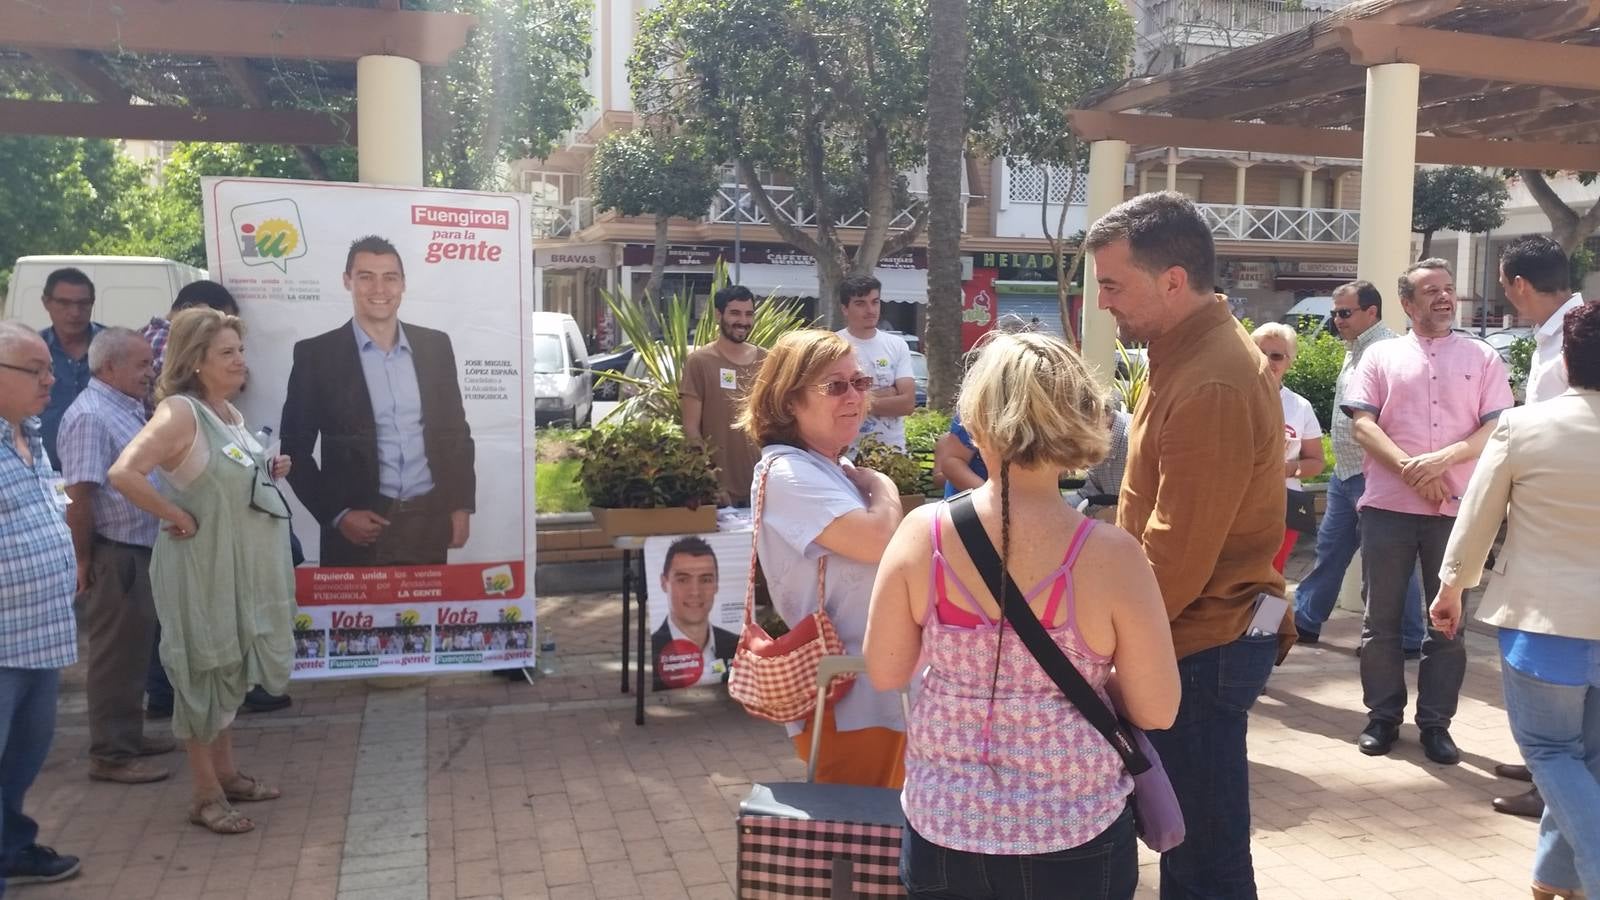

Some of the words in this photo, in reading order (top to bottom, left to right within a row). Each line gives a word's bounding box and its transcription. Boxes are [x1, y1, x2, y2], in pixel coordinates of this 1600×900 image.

[414, 207, 507, 226] Fuengirola
[432, 230, 462, 240] para
[464, 230, 476, 240] la
[425, 240, 502, 263] gente
[551, 254, 596, 263] BRAVAS
[491, 368, 519, 376] ESPAÑA
[362, 571, 387, 579] unida
[314, 592, 367, 600] FUENGIROLA
[413, 589, 442, 597] GENTE
[331, 611, 374, 629] Vota
[436, 608, 478, 625] Vota
[331, 658, 378, 668] Fuengirola
[401, 655, 431, 665] gente
[436, 654, 482, 664] Fuengirola
[504, 650, 532, 661] gente
[294, 661, 325, 671] gente
